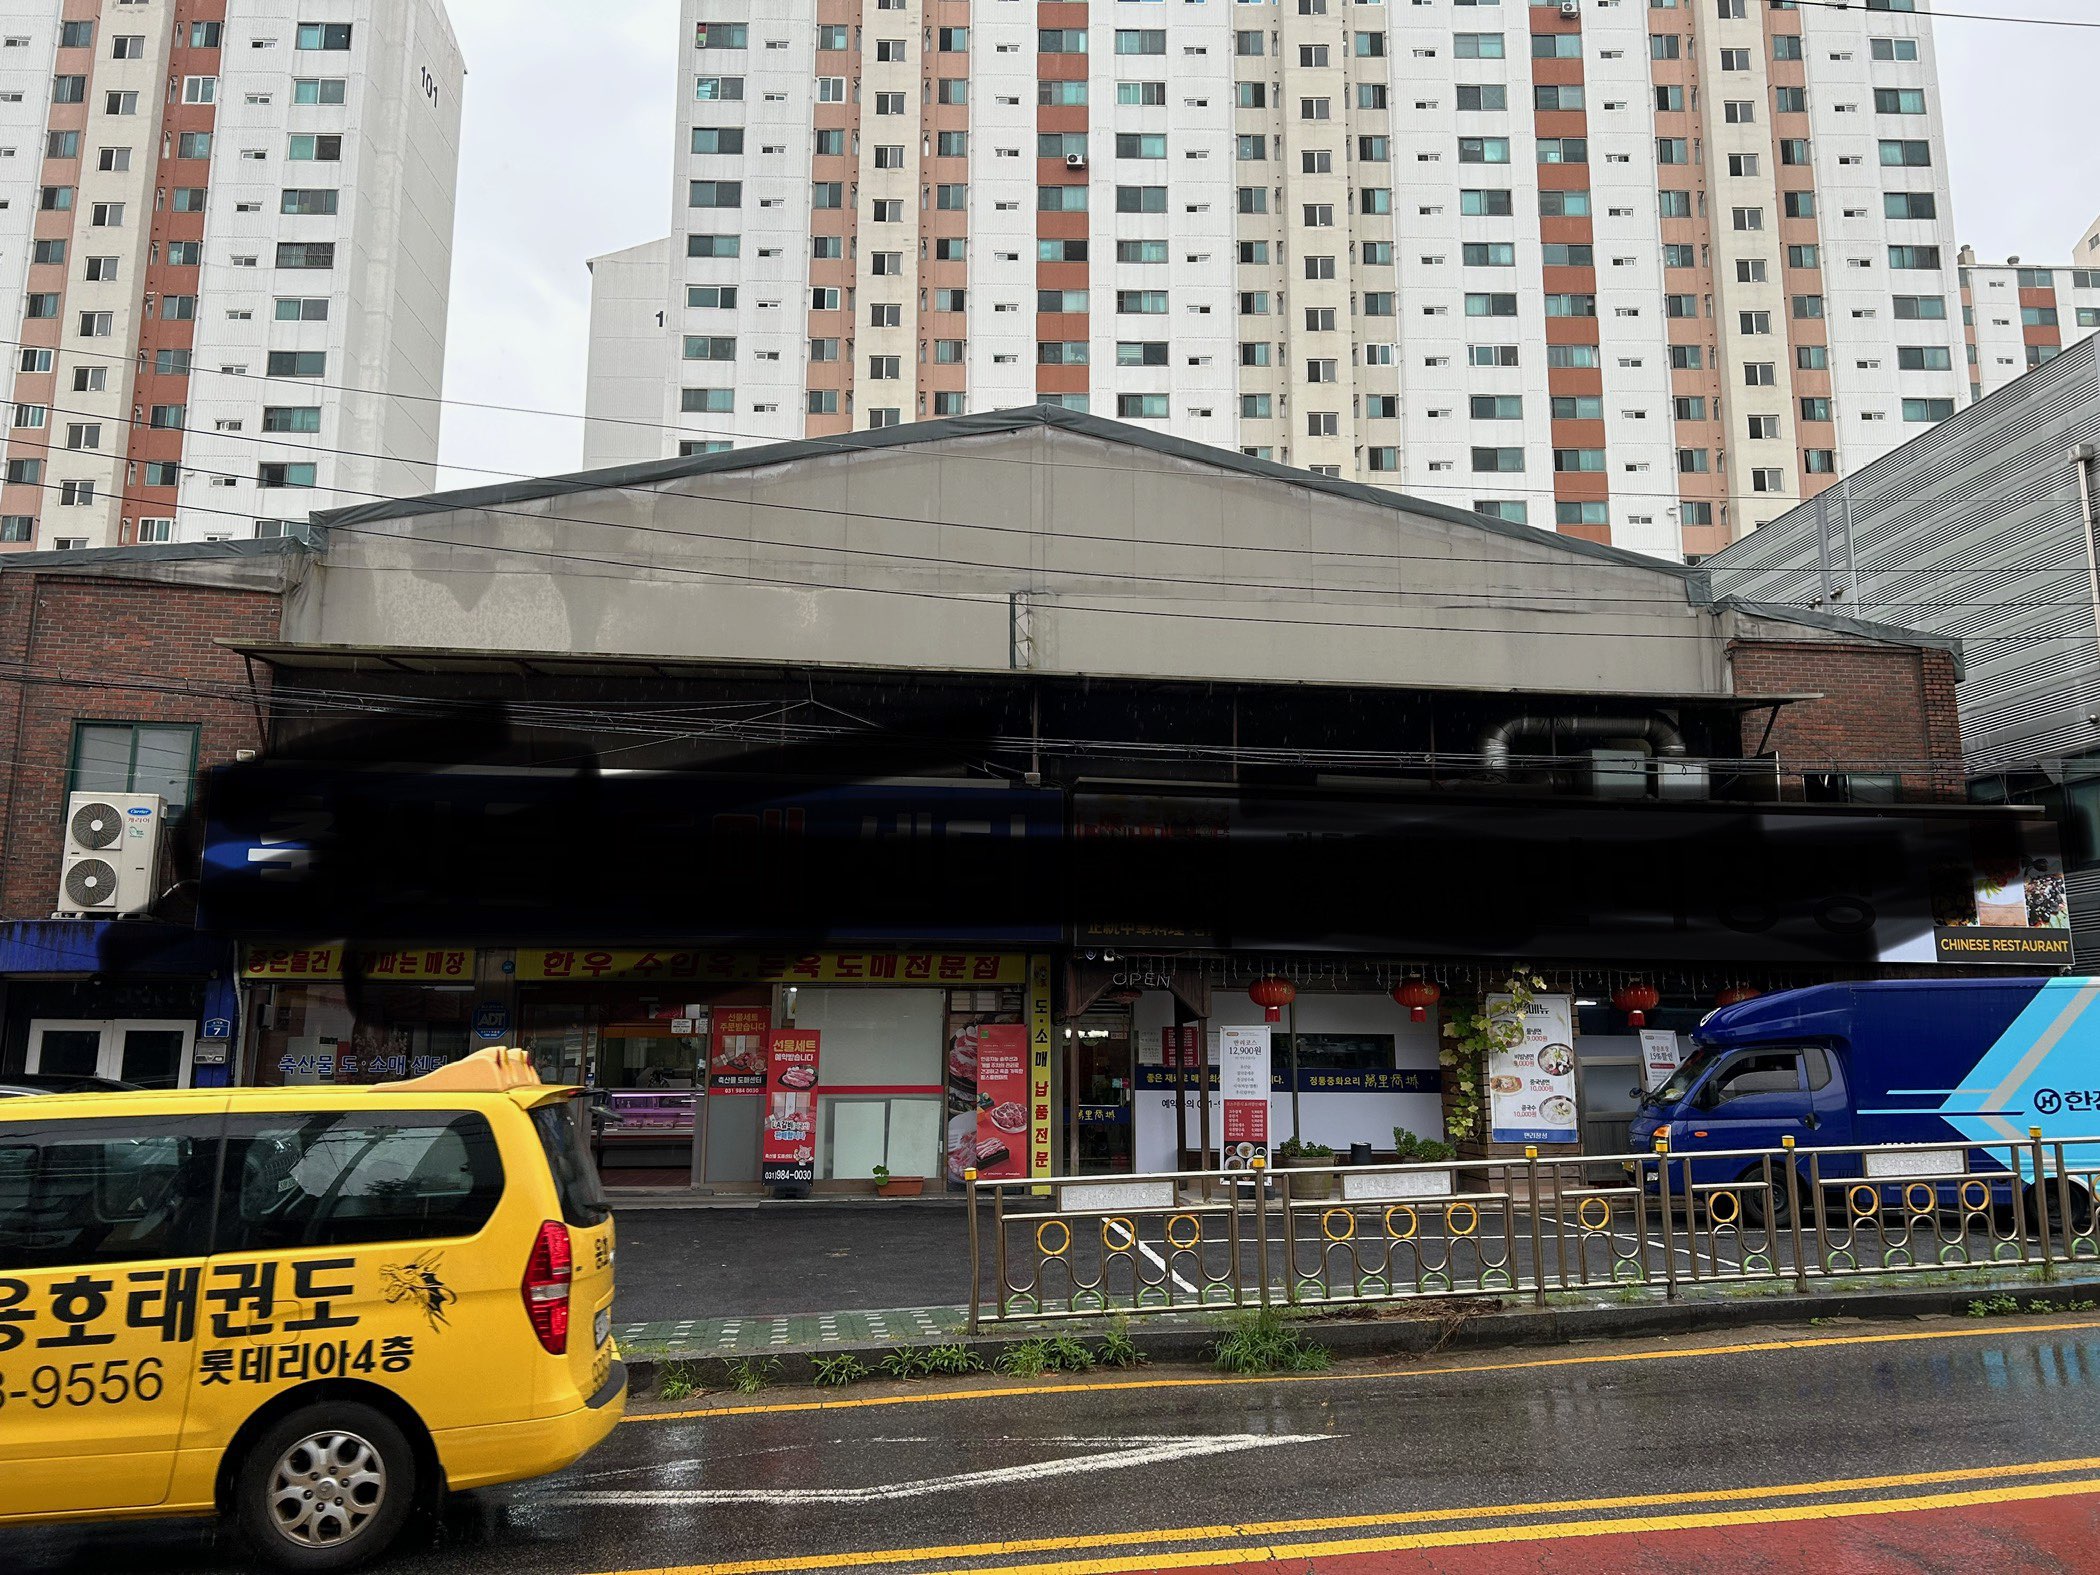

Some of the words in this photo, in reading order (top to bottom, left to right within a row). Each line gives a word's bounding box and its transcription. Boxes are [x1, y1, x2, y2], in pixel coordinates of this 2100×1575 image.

[420, 66, 438, 108] 101
[1940, 938, 1990, 951] CHINESE
[1992, 939, 2069, 952] RESTAURANT
[248, 951, 331, 973] 좋은물건
[425, 951, 465, 975] 매장
[834, 954, 1001, 980] 도매전문점
[1112, 972, 1171, 989] OPEN
[478, 1013, 506, 1026] ADT
[728, 1013, 759, 1021] 선물세트
[213, 1027, 221, 1036] 7
[720, 1022, 767, 1032] 주문받습니다
[773, 1040, 816, 1052] 선물세트
[1229, 1046, 1262, 1055] 12,900원
[774, 1053, 814, 1061] 예약받습니다
[278, 1055, 335, 1075] 축산물
[411, 1055, 449, 1075] 센터
[1146, 1073, 1163, 1084] 좋은
[1309, 1076, 1361, 1086] 정통중화요리
[199, 1335, 415, 1387] 롯데리아4층
